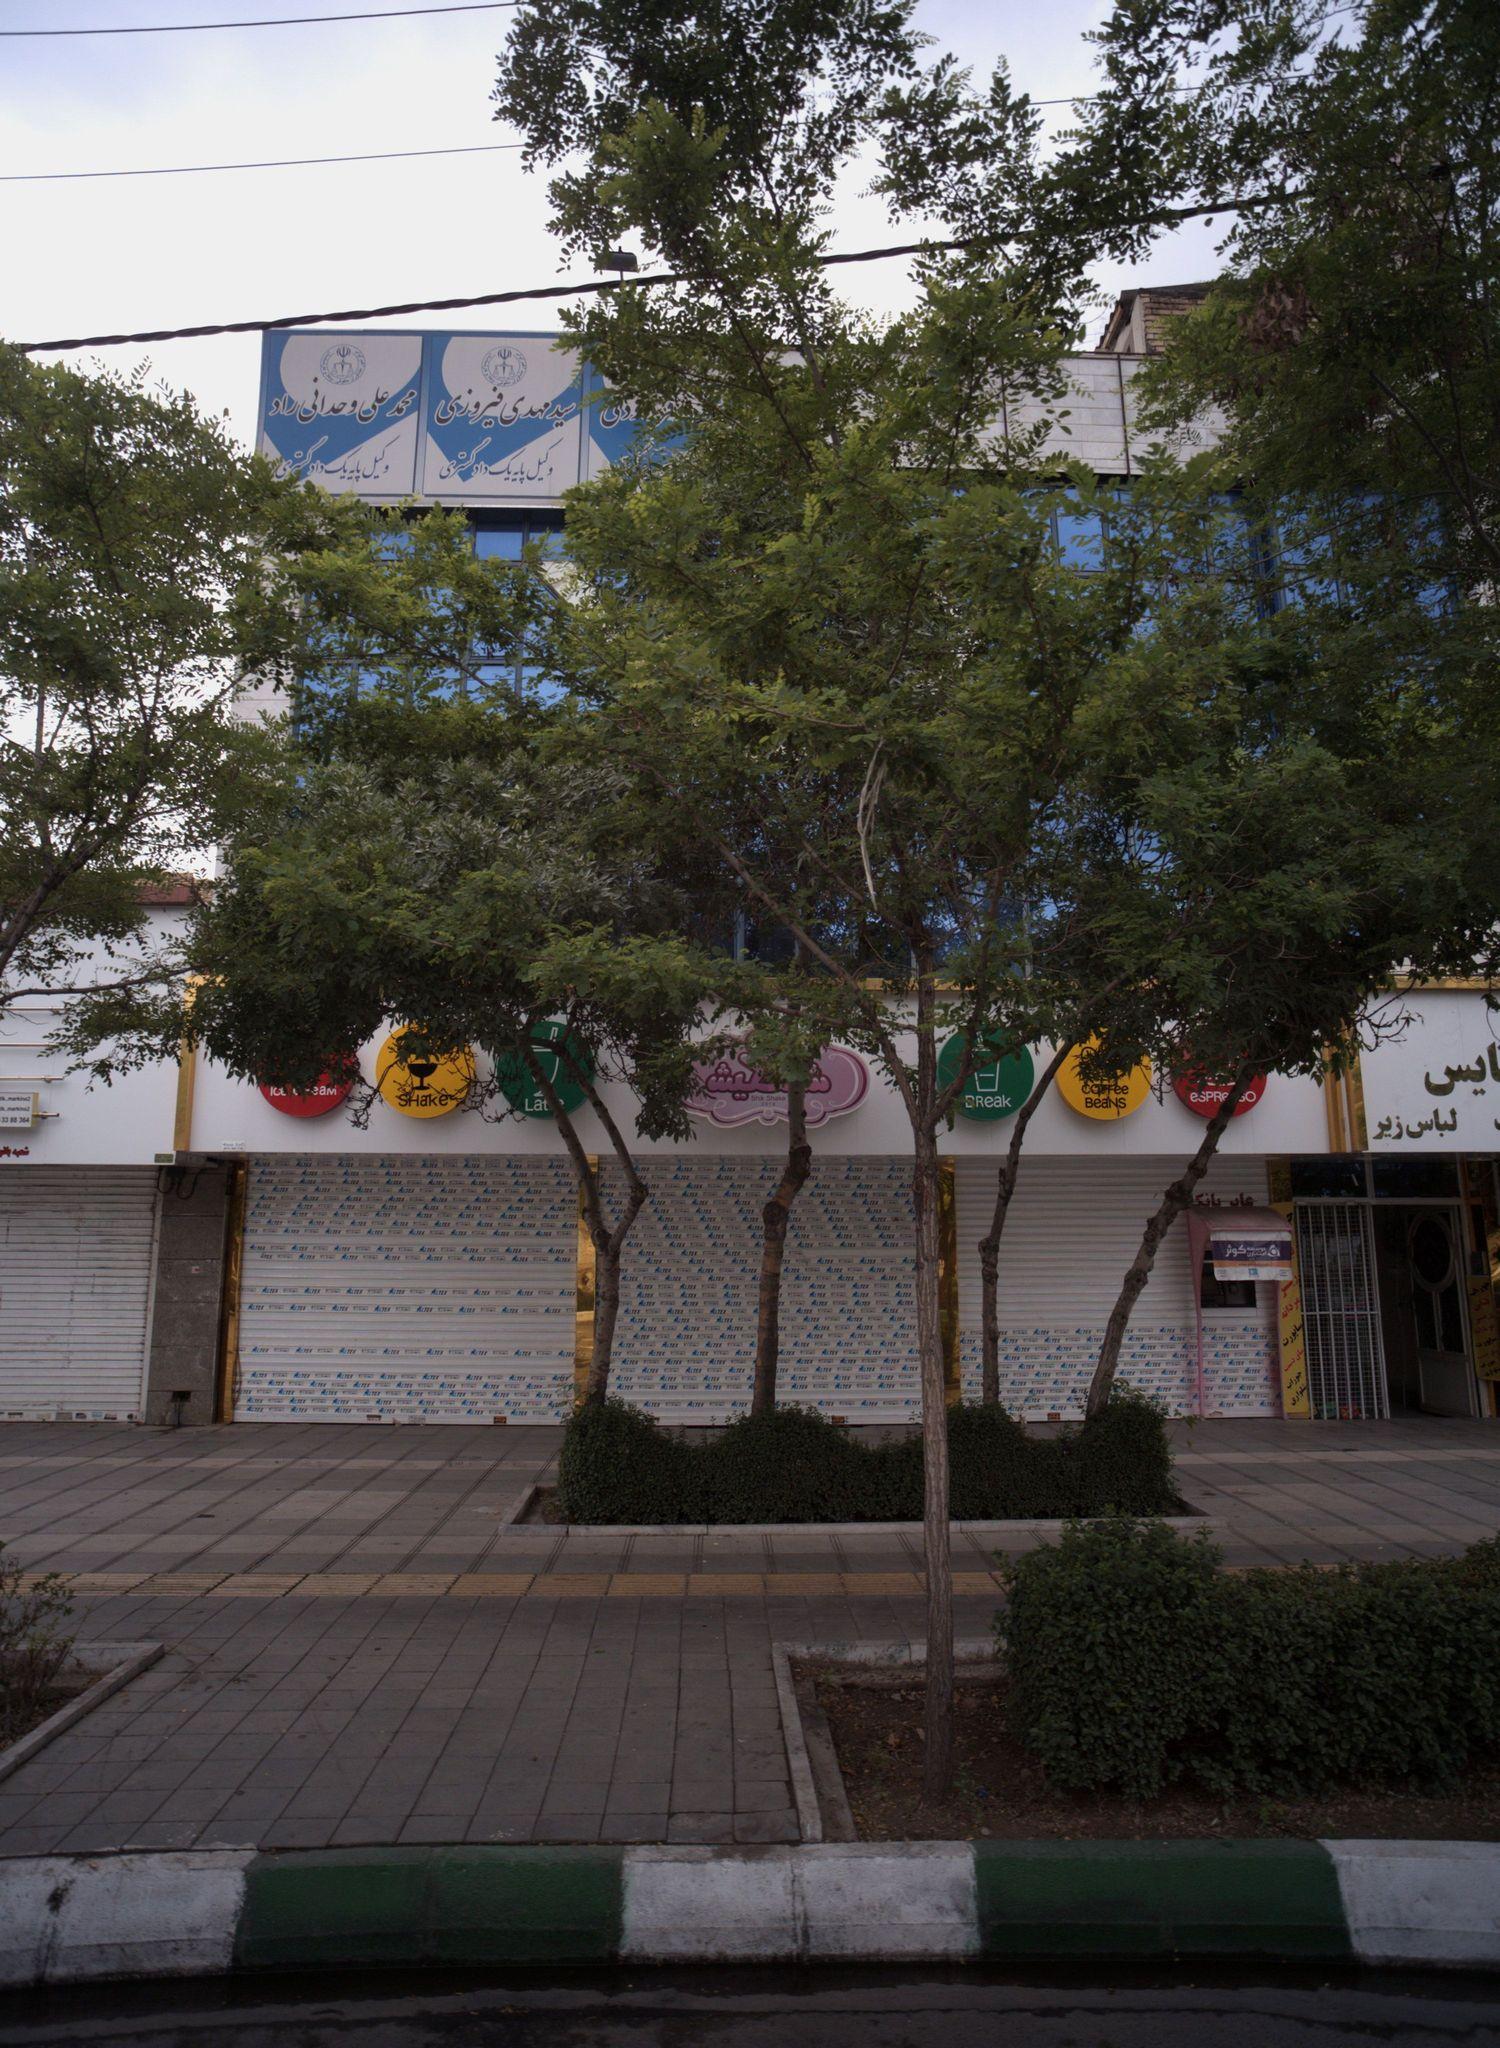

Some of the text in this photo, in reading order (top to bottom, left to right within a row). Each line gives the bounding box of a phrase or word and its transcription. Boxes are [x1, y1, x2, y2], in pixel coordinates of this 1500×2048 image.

[269, 393, 304, 417] راد
[357, 387, 389, 424] علی
[387, 389, 417, 417] محمد
[435, 386, 504, 428] فیروزی
[498, 396, 550, 427] مهدی
[545, 402, 577, 428] سید
[362, 435, 400, 479] وکیل
[526, 437, 564, 481] وکیل
[1424, 1041, 1500, 1096] ایس
[1372, 1107, 1458, 1140] لباس زیر
